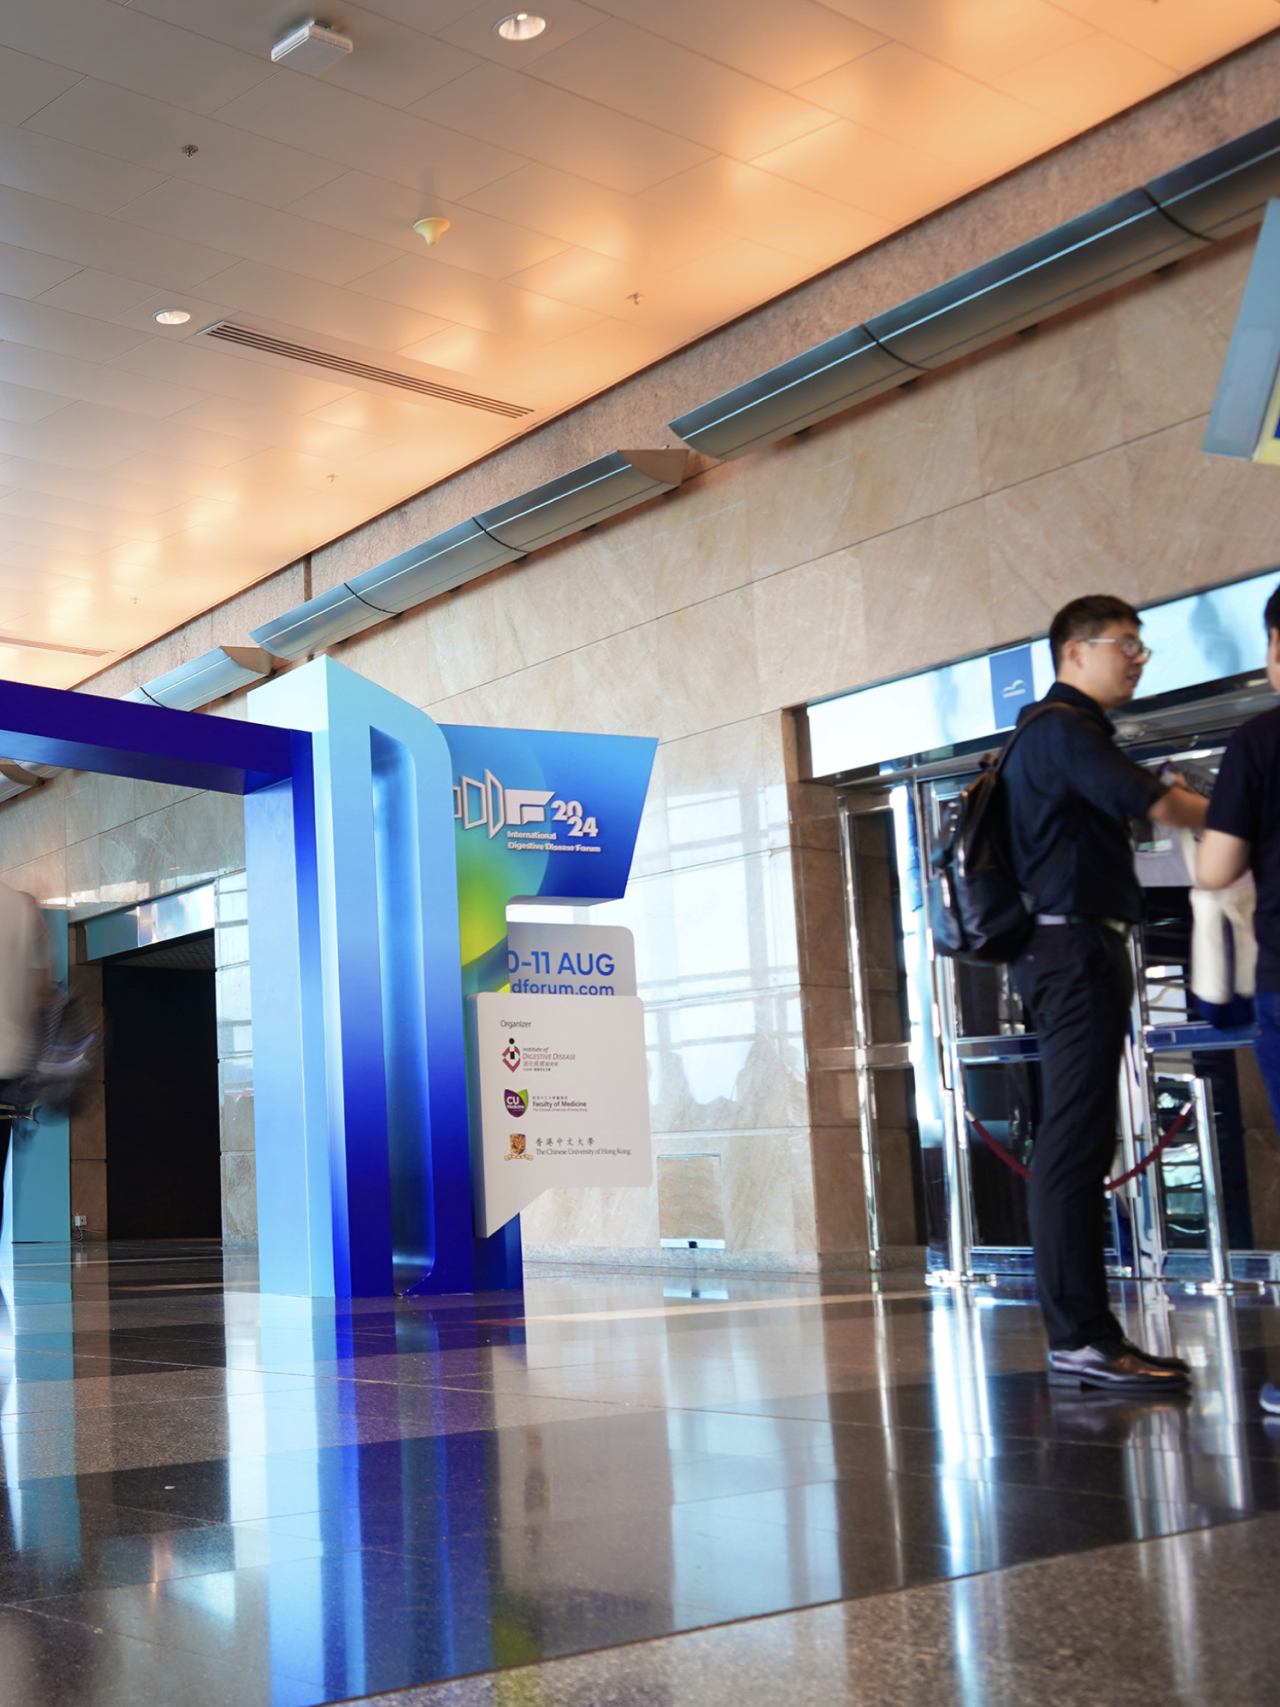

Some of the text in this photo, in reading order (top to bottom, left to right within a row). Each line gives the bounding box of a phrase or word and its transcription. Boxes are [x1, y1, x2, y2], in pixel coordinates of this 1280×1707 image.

[507, 830, 557, 840] International
[507, 841, 602, 853] Digestive Disease Forum
[557, 952, 615, 976] AUG
[511, 979, 615, 996] dforum.com
[500, 1020, 532, 1029] Organizer
[506, 1096, 520, 1105] CU
[568, 1148, 594, 1156] University
[601, 1148, 616, 1156] Hong
[616, 1148, 631, 1157] Kong
